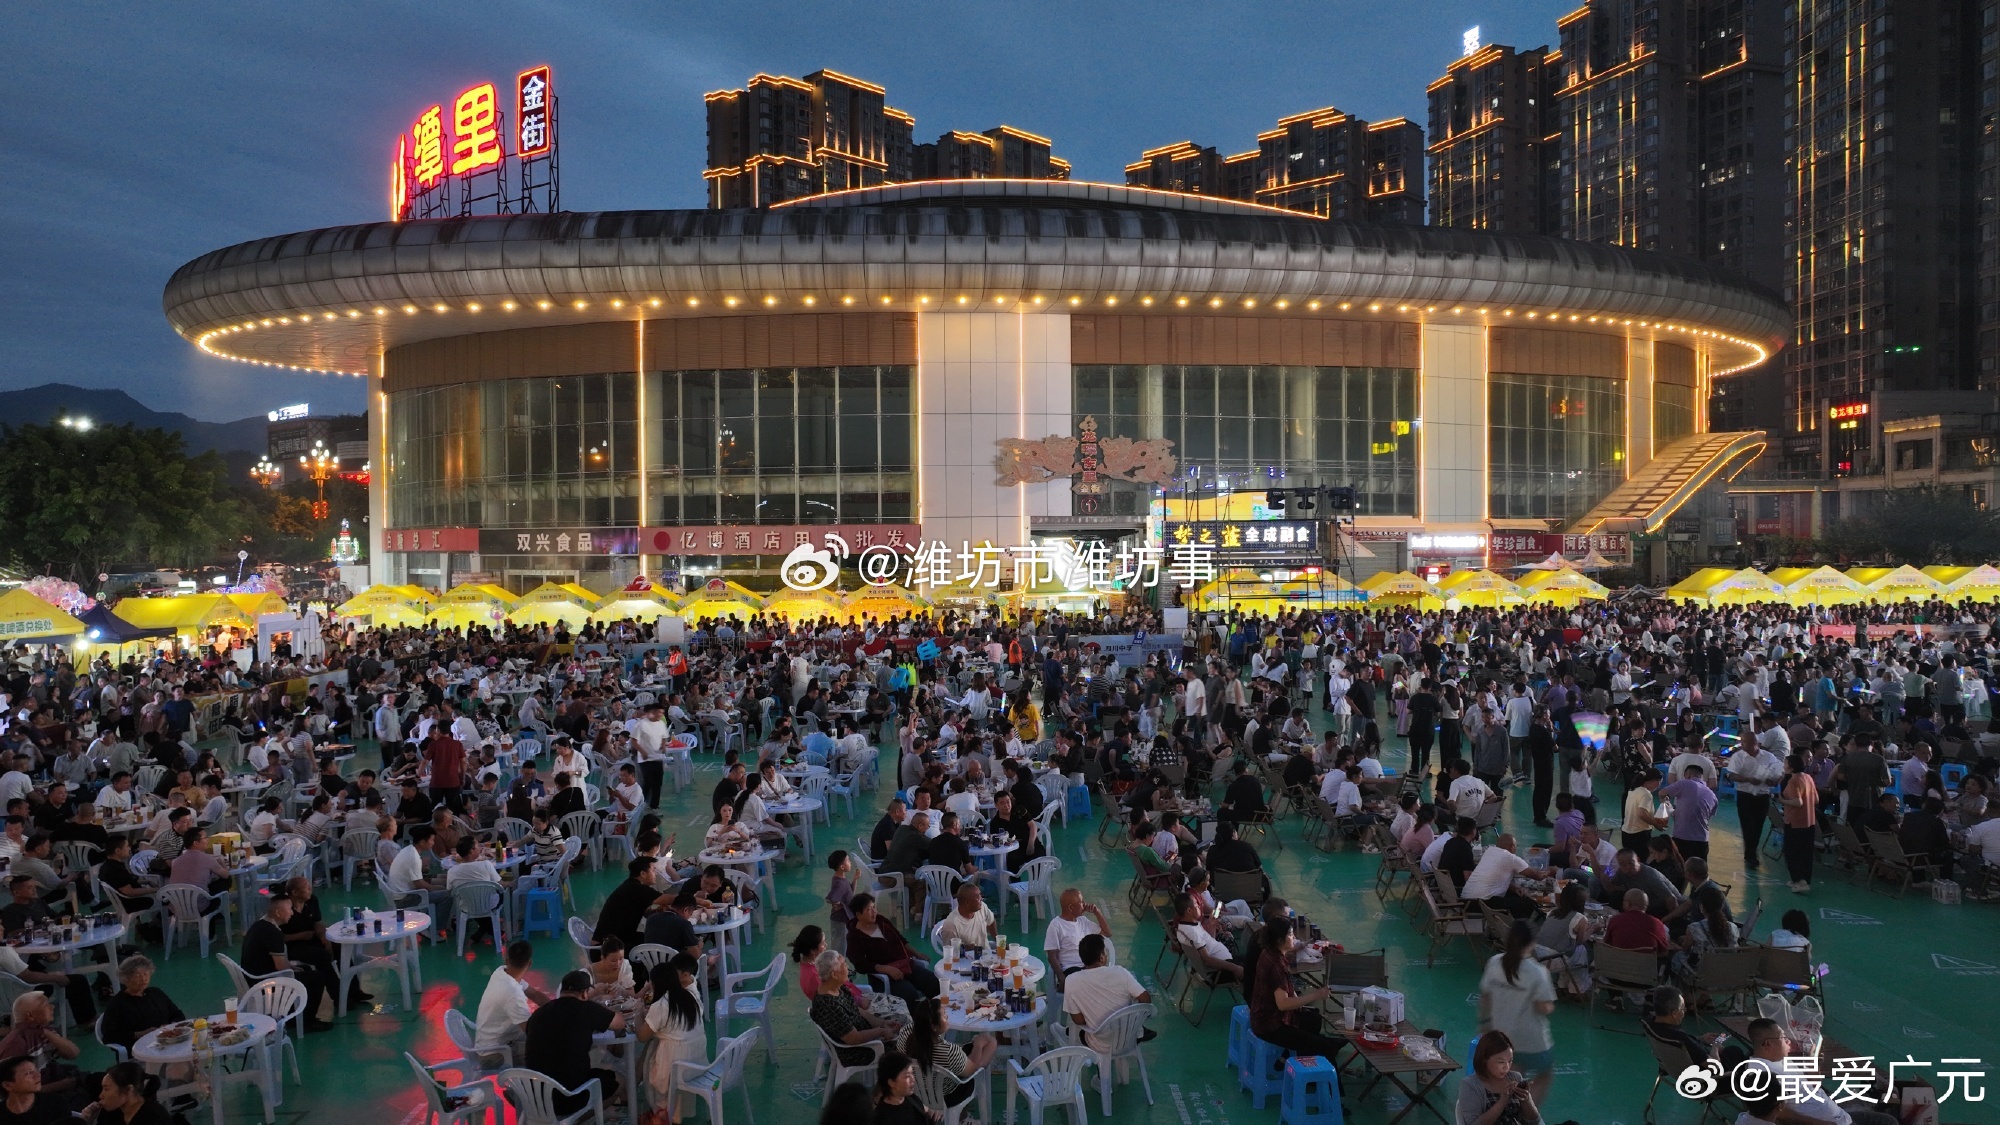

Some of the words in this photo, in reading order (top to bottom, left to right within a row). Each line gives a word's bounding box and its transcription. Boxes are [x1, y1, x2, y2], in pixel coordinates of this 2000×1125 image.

[522, 75, 546, 151] 金街
[516, 532, 593, 553] 双兴食品
[679, 530, 904, 549] 亿博酒店用品批发
[1492, 535, 1536, 550] 华珍副食
